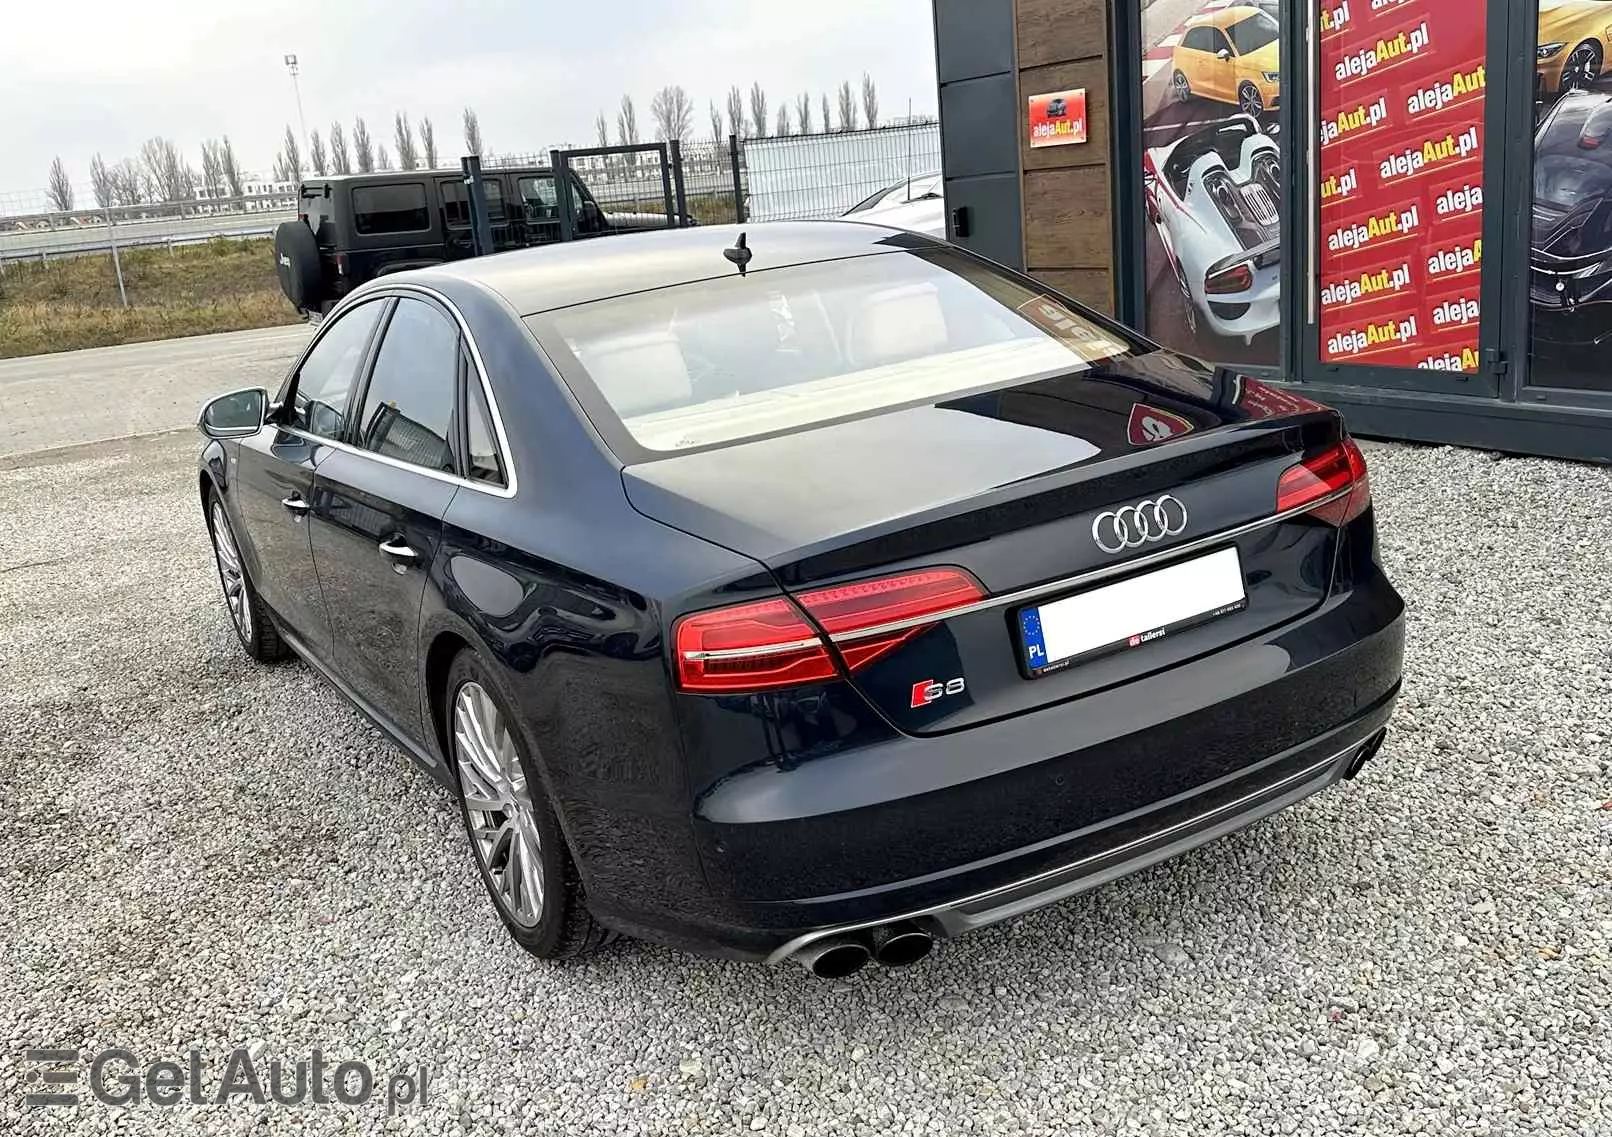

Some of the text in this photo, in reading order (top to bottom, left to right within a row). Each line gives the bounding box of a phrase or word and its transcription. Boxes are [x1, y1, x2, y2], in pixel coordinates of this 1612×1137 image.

[1335, 22, 1429, 81] alejaAut.pl
[1033, 118, 1083, 137] alejaAut.pl
[1380, 126, 1478, 179] alejaAut.pl
[1436, 184, 1483, 215] aleja
[1328, 205, 1419, 251] alejaAut.pl
[1321, 263, 1411, 305] alejaAut.pl
[1433, 297, 1479, 325] aleja
[1328, 315, 1418, 354] alejaAut.pl
[1028, 644, 1045, 660] PL
[919, 677, 965, 703] S8
